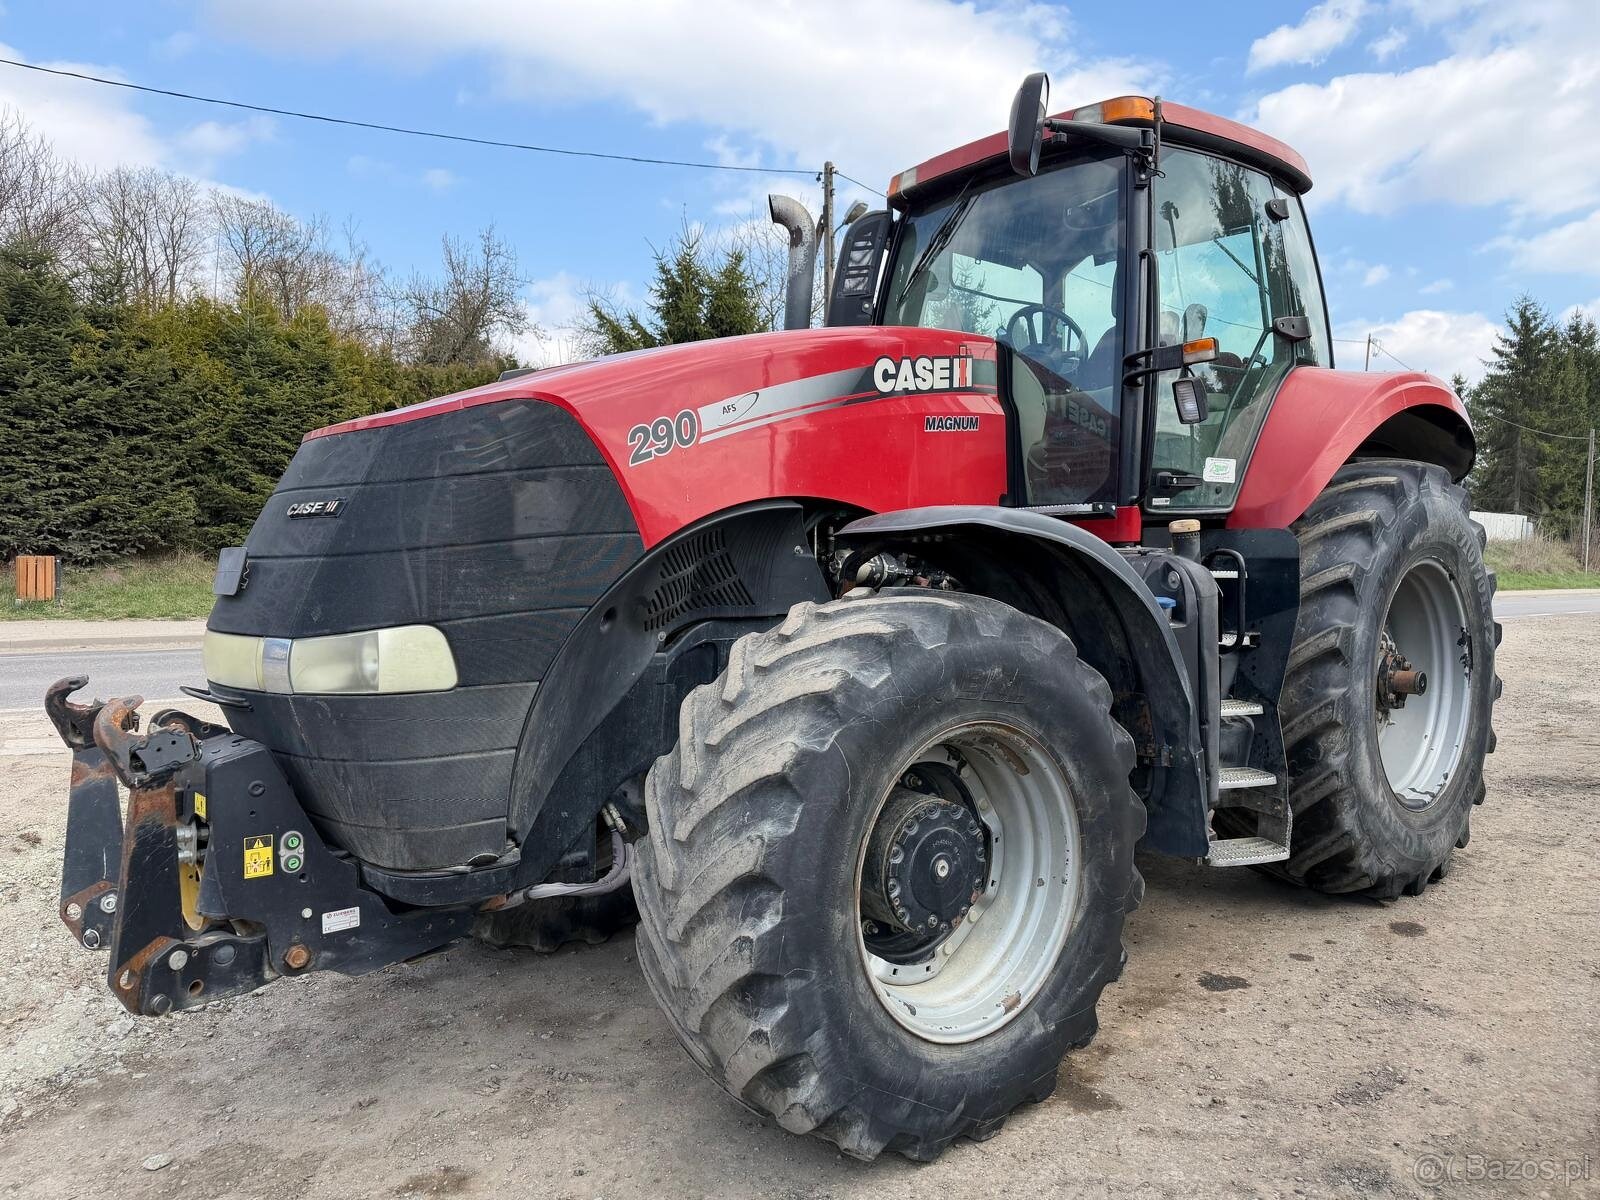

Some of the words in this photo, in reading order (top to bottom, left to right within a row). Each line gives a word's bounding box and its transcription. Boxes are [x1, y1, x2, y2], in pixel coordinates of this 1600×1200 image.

[722, 403, 737, 415] AFS
[924, 415, 979, 432] MAGNUM
[627, 409, 697, 467] 290
[287, 502, 324, 516] CASE
